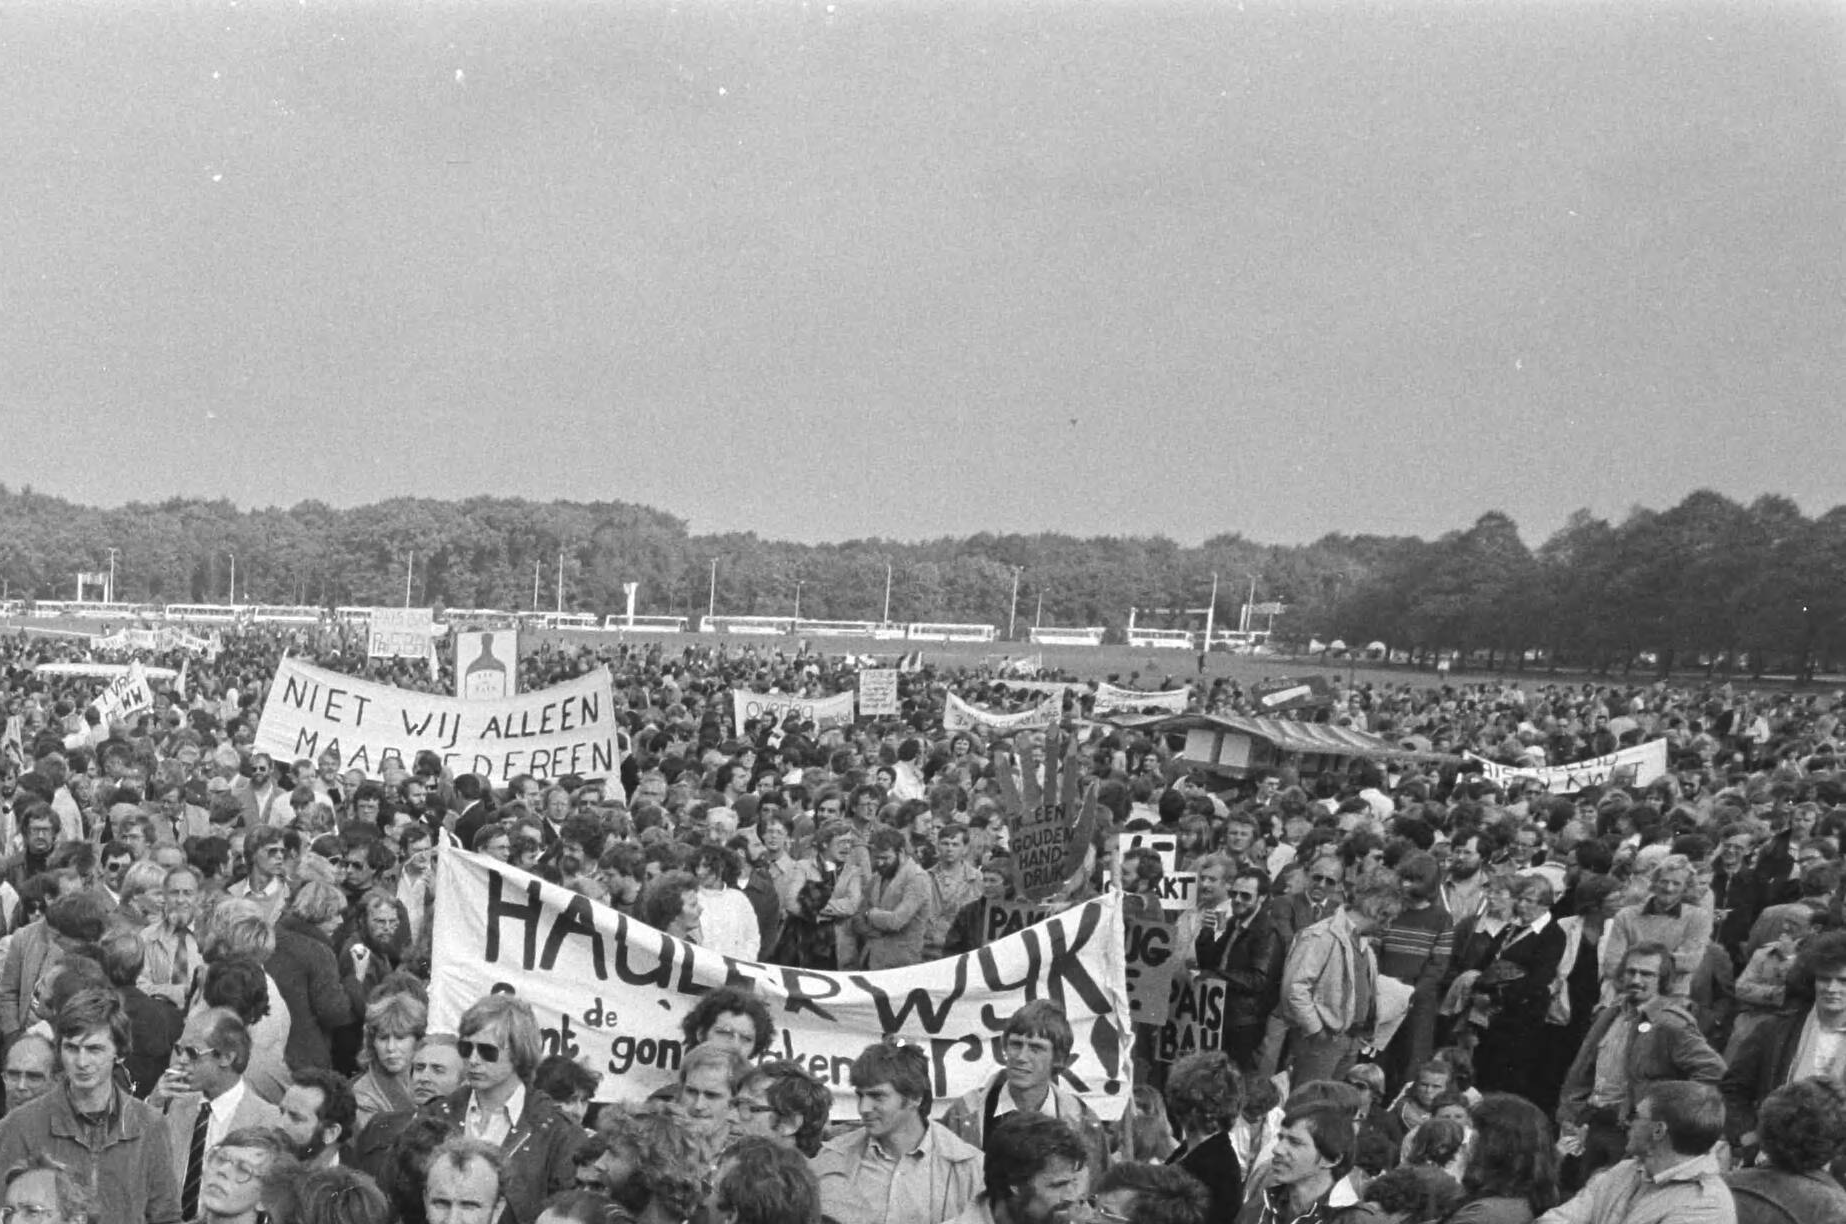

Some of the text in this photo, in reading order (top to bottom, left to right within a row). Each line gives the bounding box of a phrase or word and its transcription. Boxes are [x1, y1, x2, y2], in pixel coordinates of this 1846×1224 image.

[283, 676, 599, 749] NIET WIJ ALLEEN
[1034, 803, 1067, 824] EEN
[1012, 826, 1075, 852] GOUDEN
[1024, 864, 1066, 889] DRUK
[583, 997, 618, 1028] de
